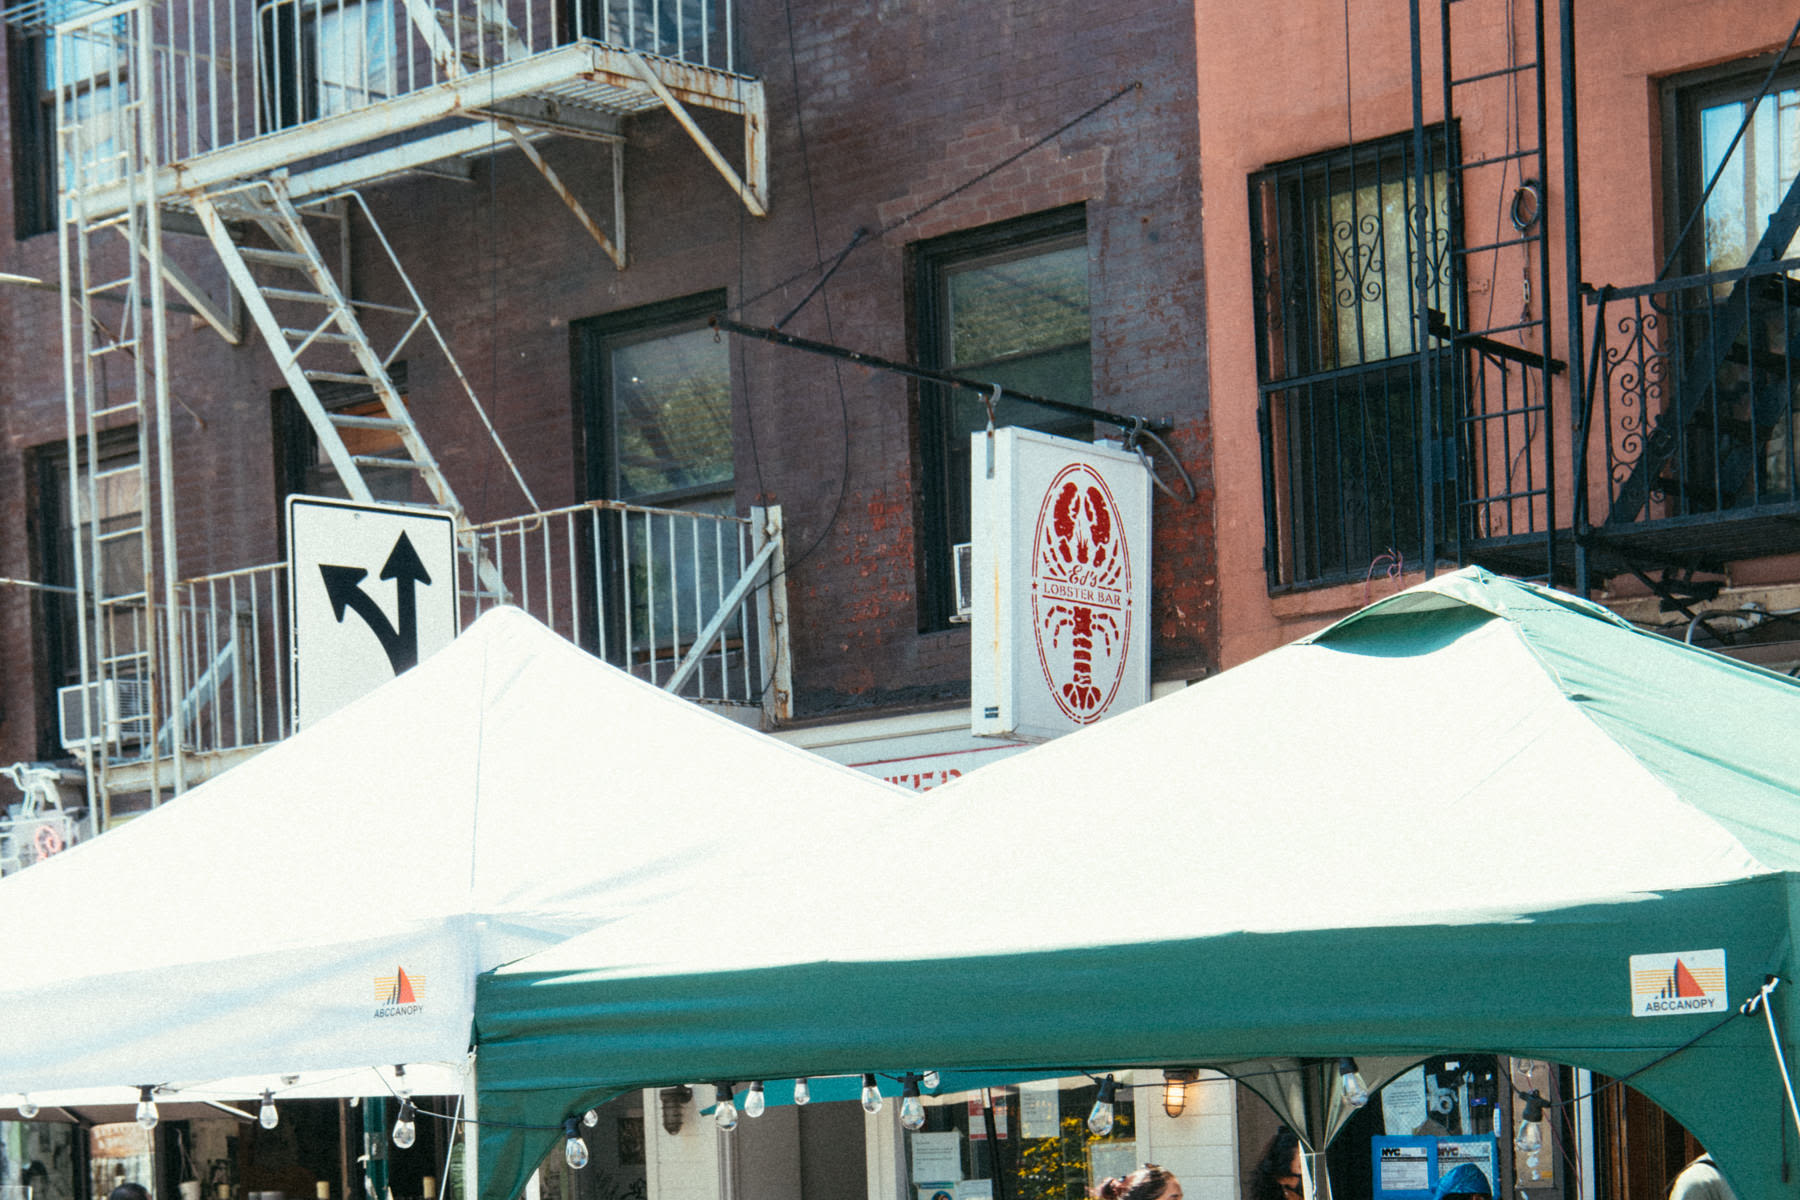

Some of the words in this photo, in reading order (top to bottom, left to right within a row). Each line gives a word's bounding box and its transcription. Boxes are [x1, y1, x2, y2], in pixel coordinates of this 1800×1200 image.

[1068, 564, 1097, 588] Ed's
[1043, 582, 1094, 601] LOBSTER
[1098, 591, 1121, 606] BAR
[373, 1005, 424, 1018] ABCCANOPY
[1646, 998, 1716, 1012] ABCCANOPY
[1382, 1148, 1401, 1157] NYC
